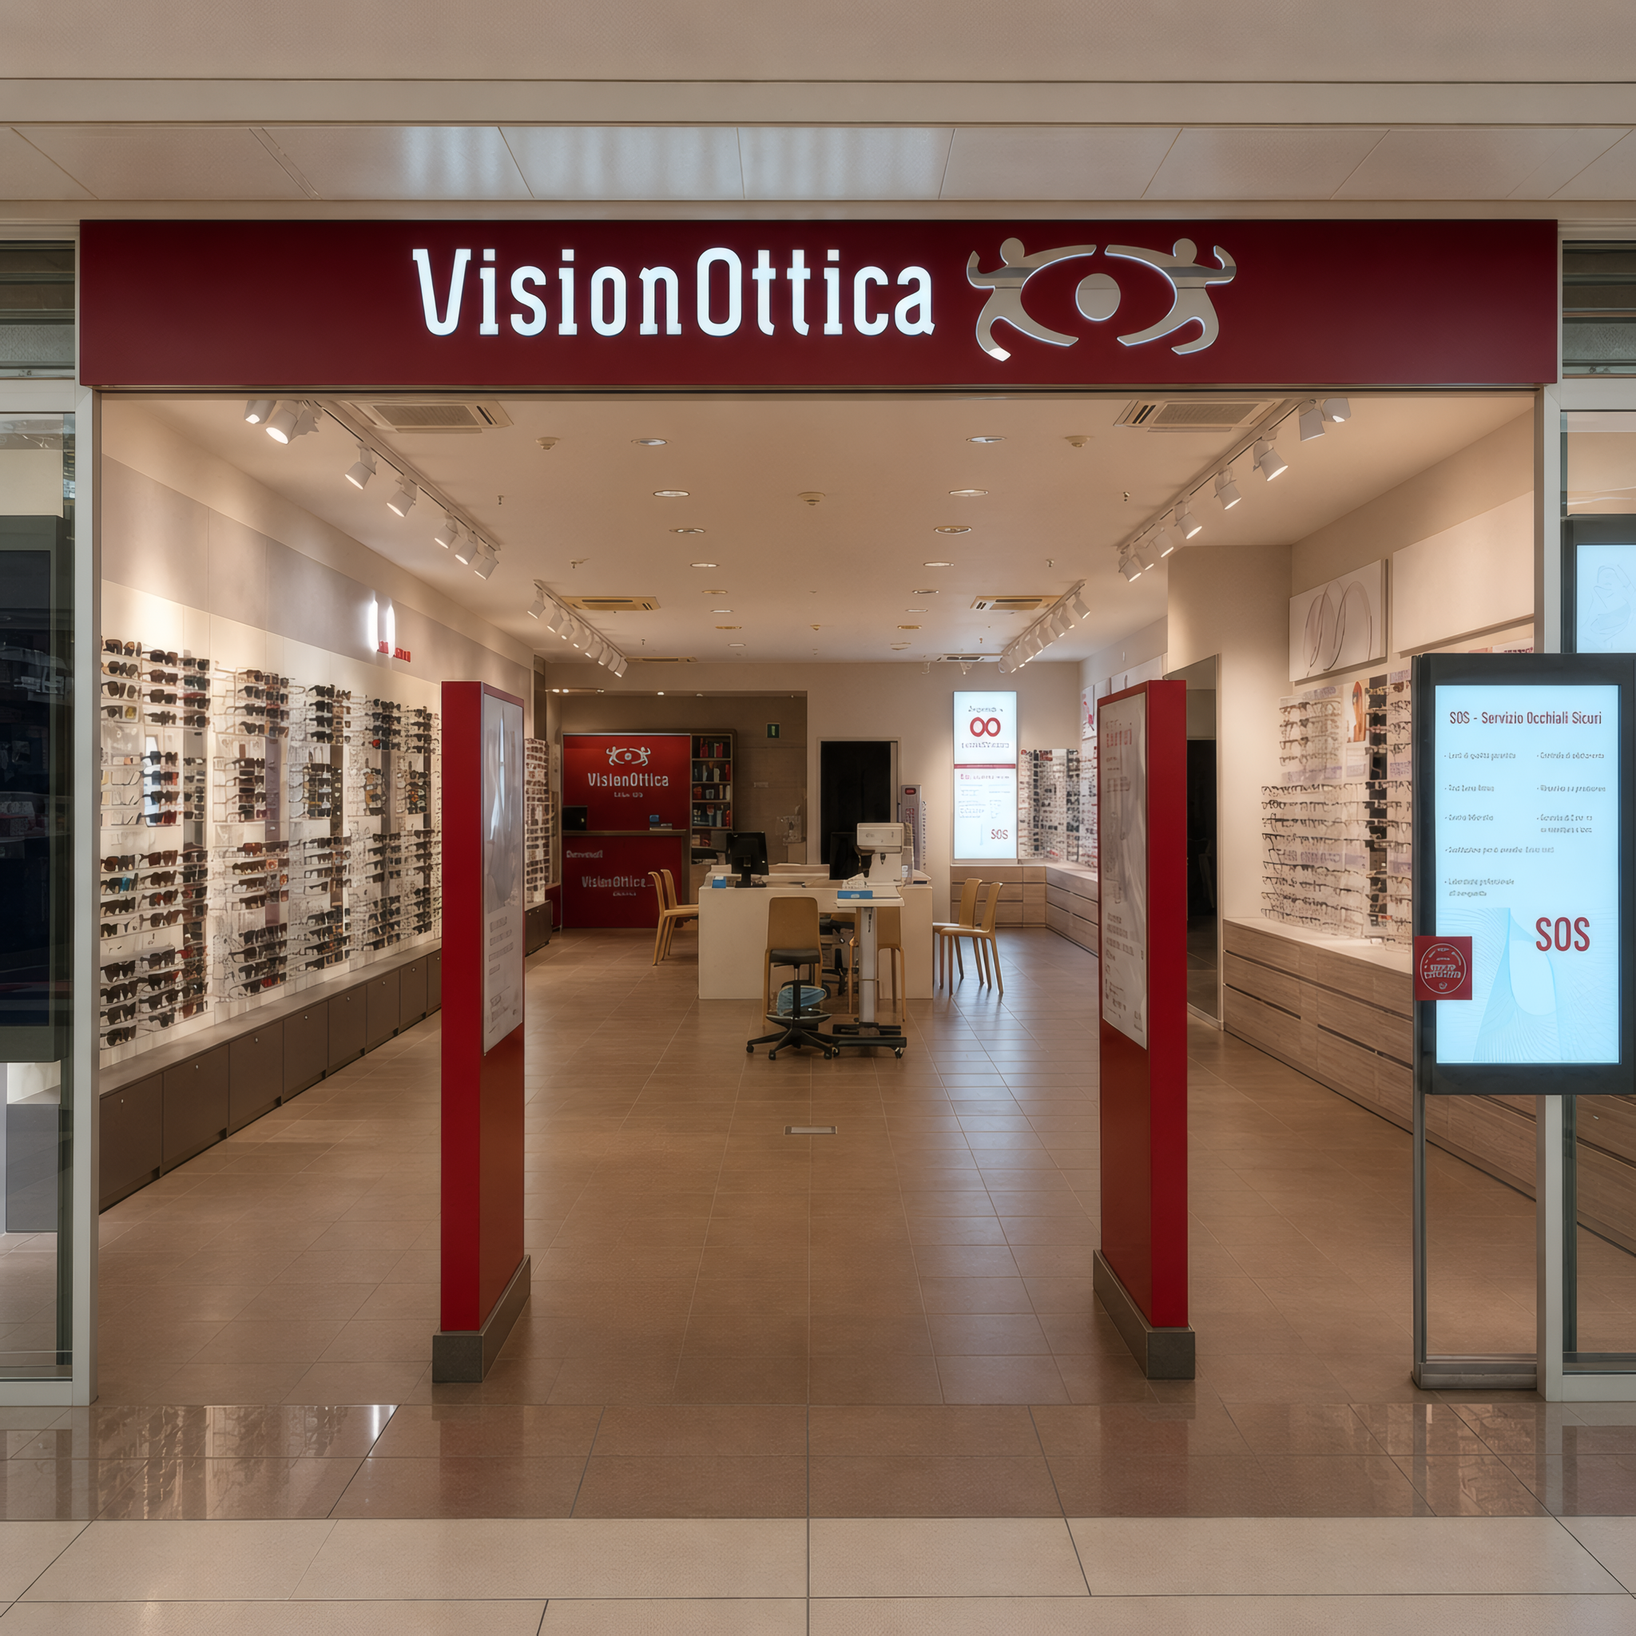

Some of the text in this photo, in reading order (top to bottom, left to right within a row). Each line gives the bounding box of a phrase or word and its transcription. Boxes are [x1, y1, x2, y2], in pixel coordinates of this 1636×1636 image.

[412, 246, 935, 337] VisionOttica
[1449, 711, 1471, 724] SOS
[1481, 711, 1524, 724] Servizio
[1526, 711, 1568, 724] Occhiali
[1571, 711, 1602, 724] Sicuri
[990, 828, 1009, 840] SOS
[1535, 916, 1590, 952] SOS
